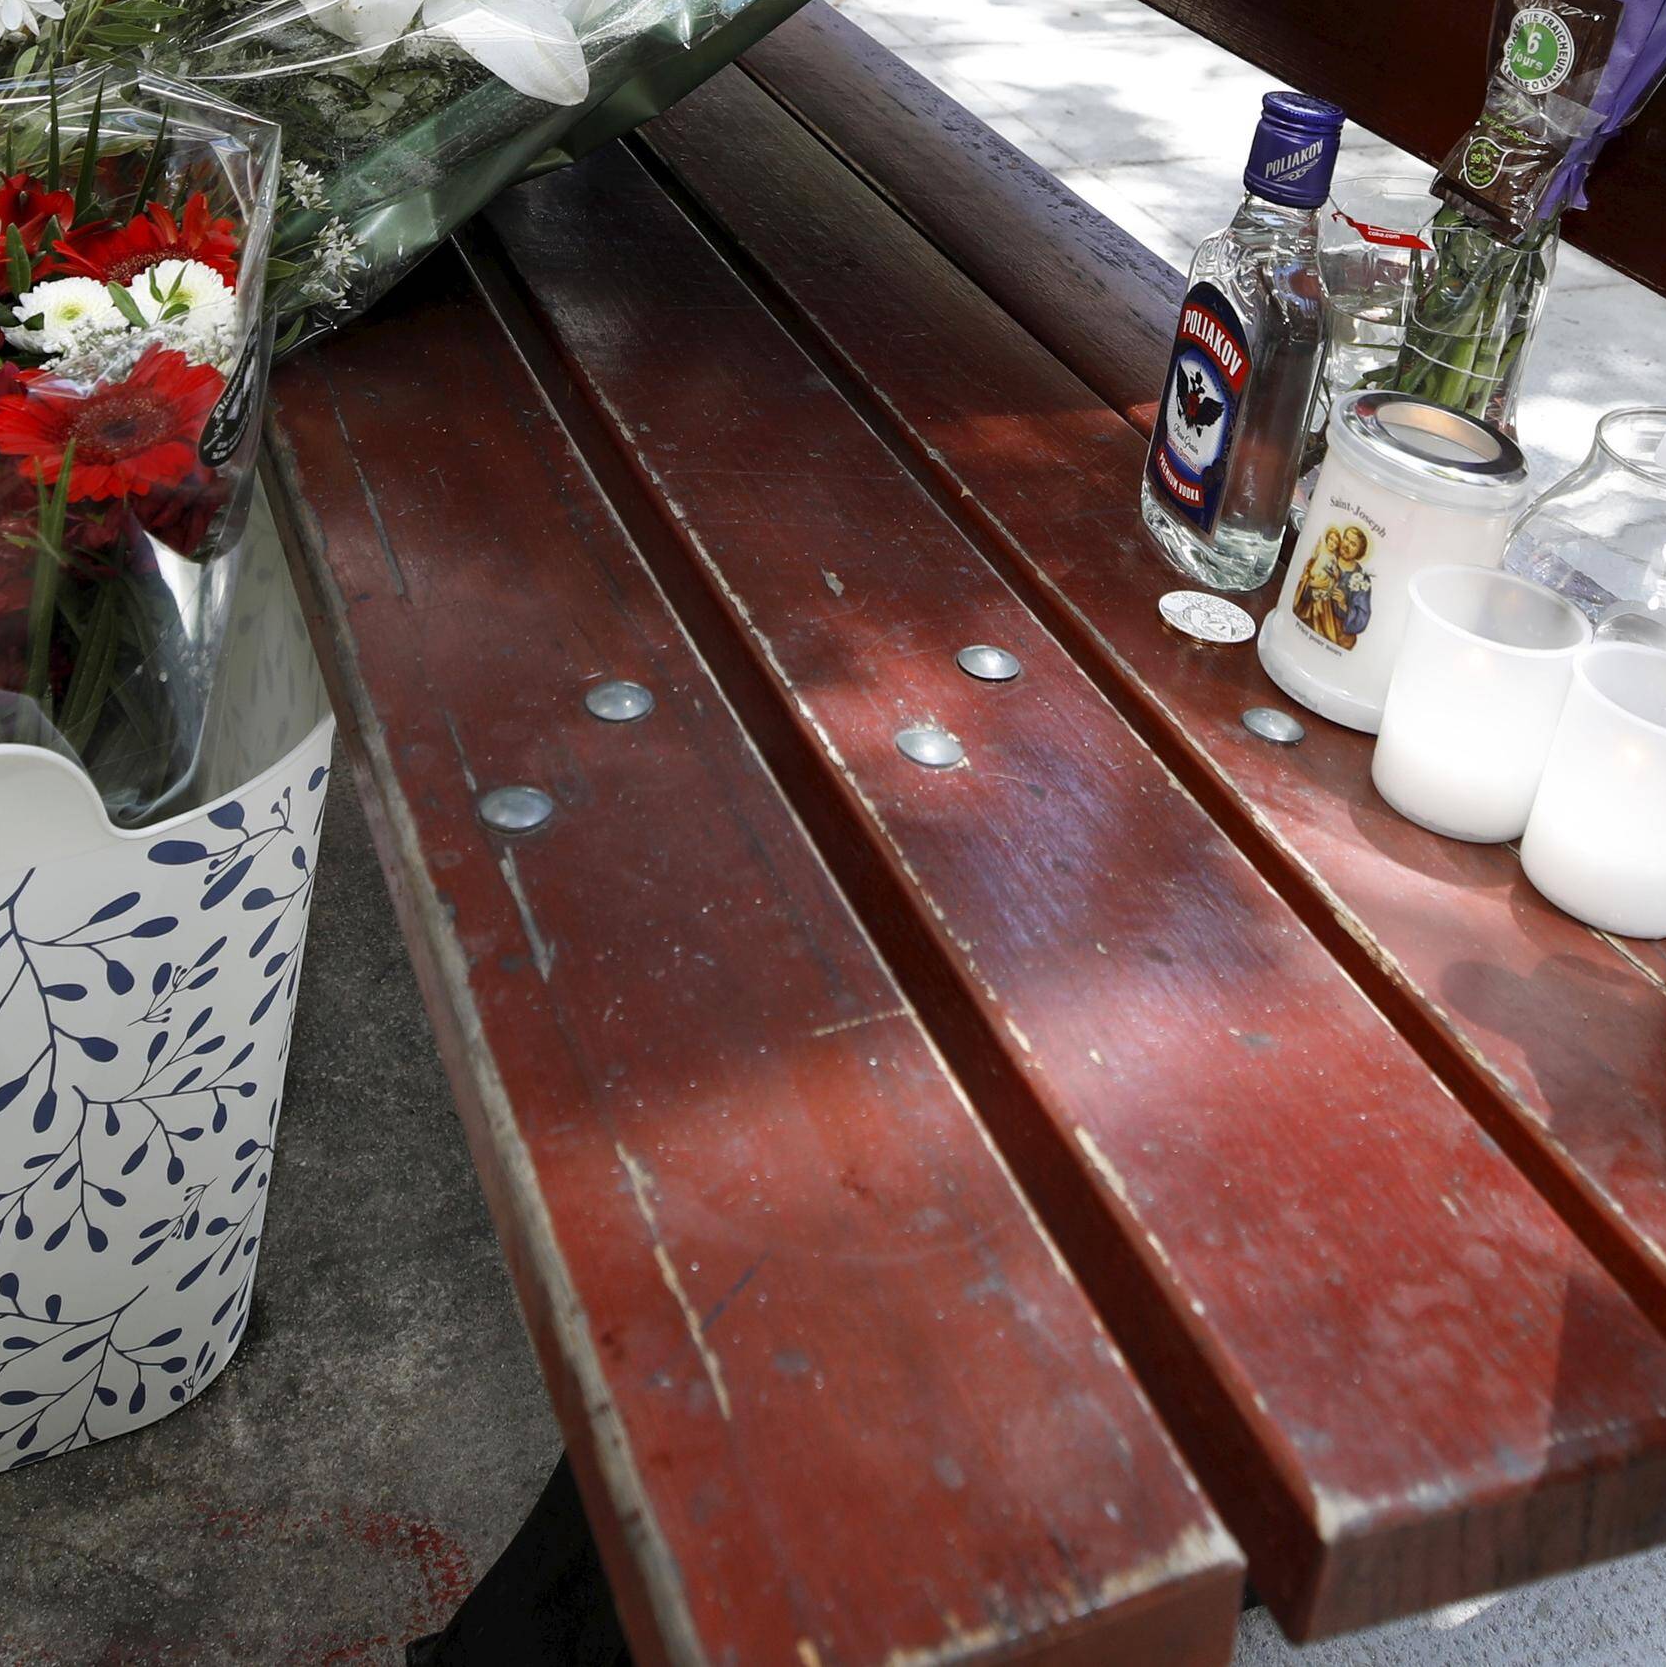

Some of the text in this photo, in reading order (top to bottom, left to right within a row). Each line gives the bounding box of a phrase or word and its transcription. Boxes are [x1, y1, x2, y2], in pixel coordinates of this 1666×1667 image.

[1512, 48, 1544, 71] jours
[1527, 32, 1543, 54] 6
[1265, 138, 1324, 179] POLIAKOV
[1367, 230, 1401, 240] coke.com
[1182, 309, 1243, 377] POLIAKOV
[1159, 452, 1179, 491] PREMIUM
[1178, 482, 1201, 502] VODKA
[1329, 496, 1387, 539] Saint-Joseph
